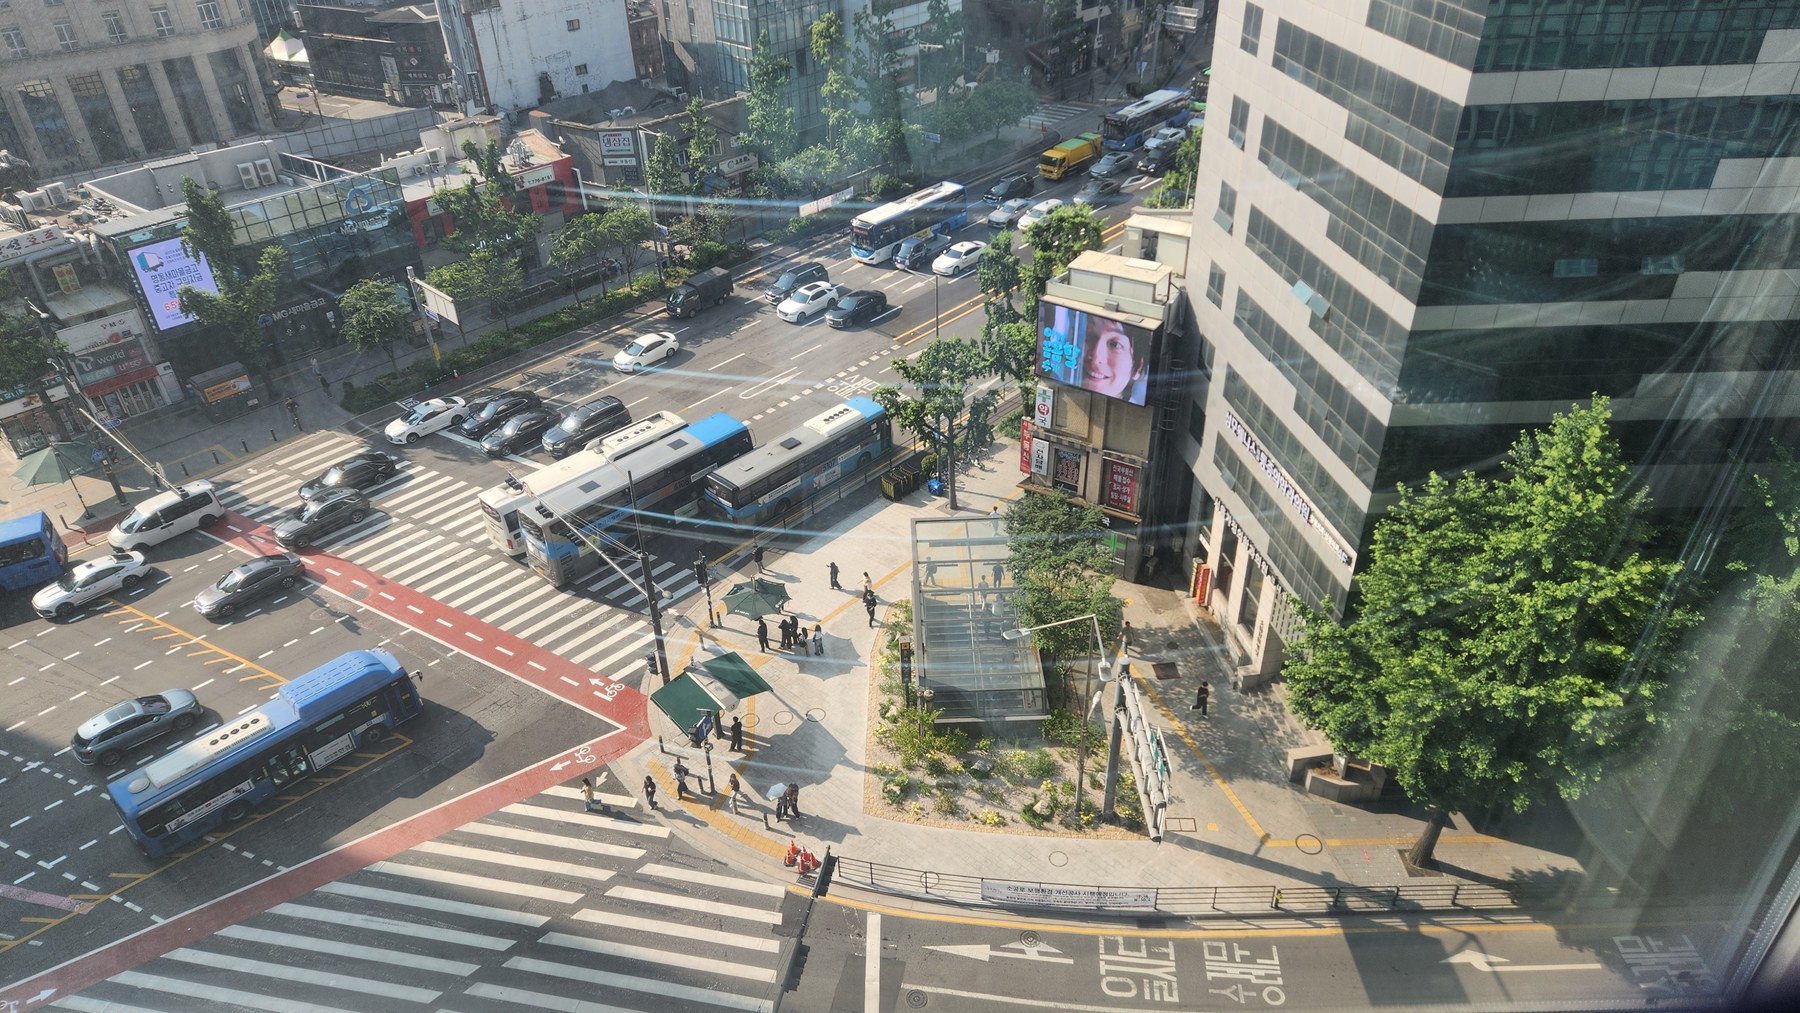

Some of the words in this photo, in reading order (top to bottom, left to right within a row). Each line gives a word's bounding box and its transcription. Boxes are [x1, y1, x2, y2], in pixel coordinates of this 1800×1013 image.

[603, 137, 631, 148] 냉삼집
[151, 263, 199, 284] 명동새마을금고
[154, 280, 176, 294] 중고차
[176, 273, 203, 286] 구입자금
[272, 297, 326, 322] MG새마을금고
[97, 349, 126, 365] world
[1038, 403, 1050, 426] 약국
[1006, 885, 1026, 893] 소공로
[1099, 935, 1180, 1003] 을지로
[1202, 940, 1287, 1006] 숭례문
